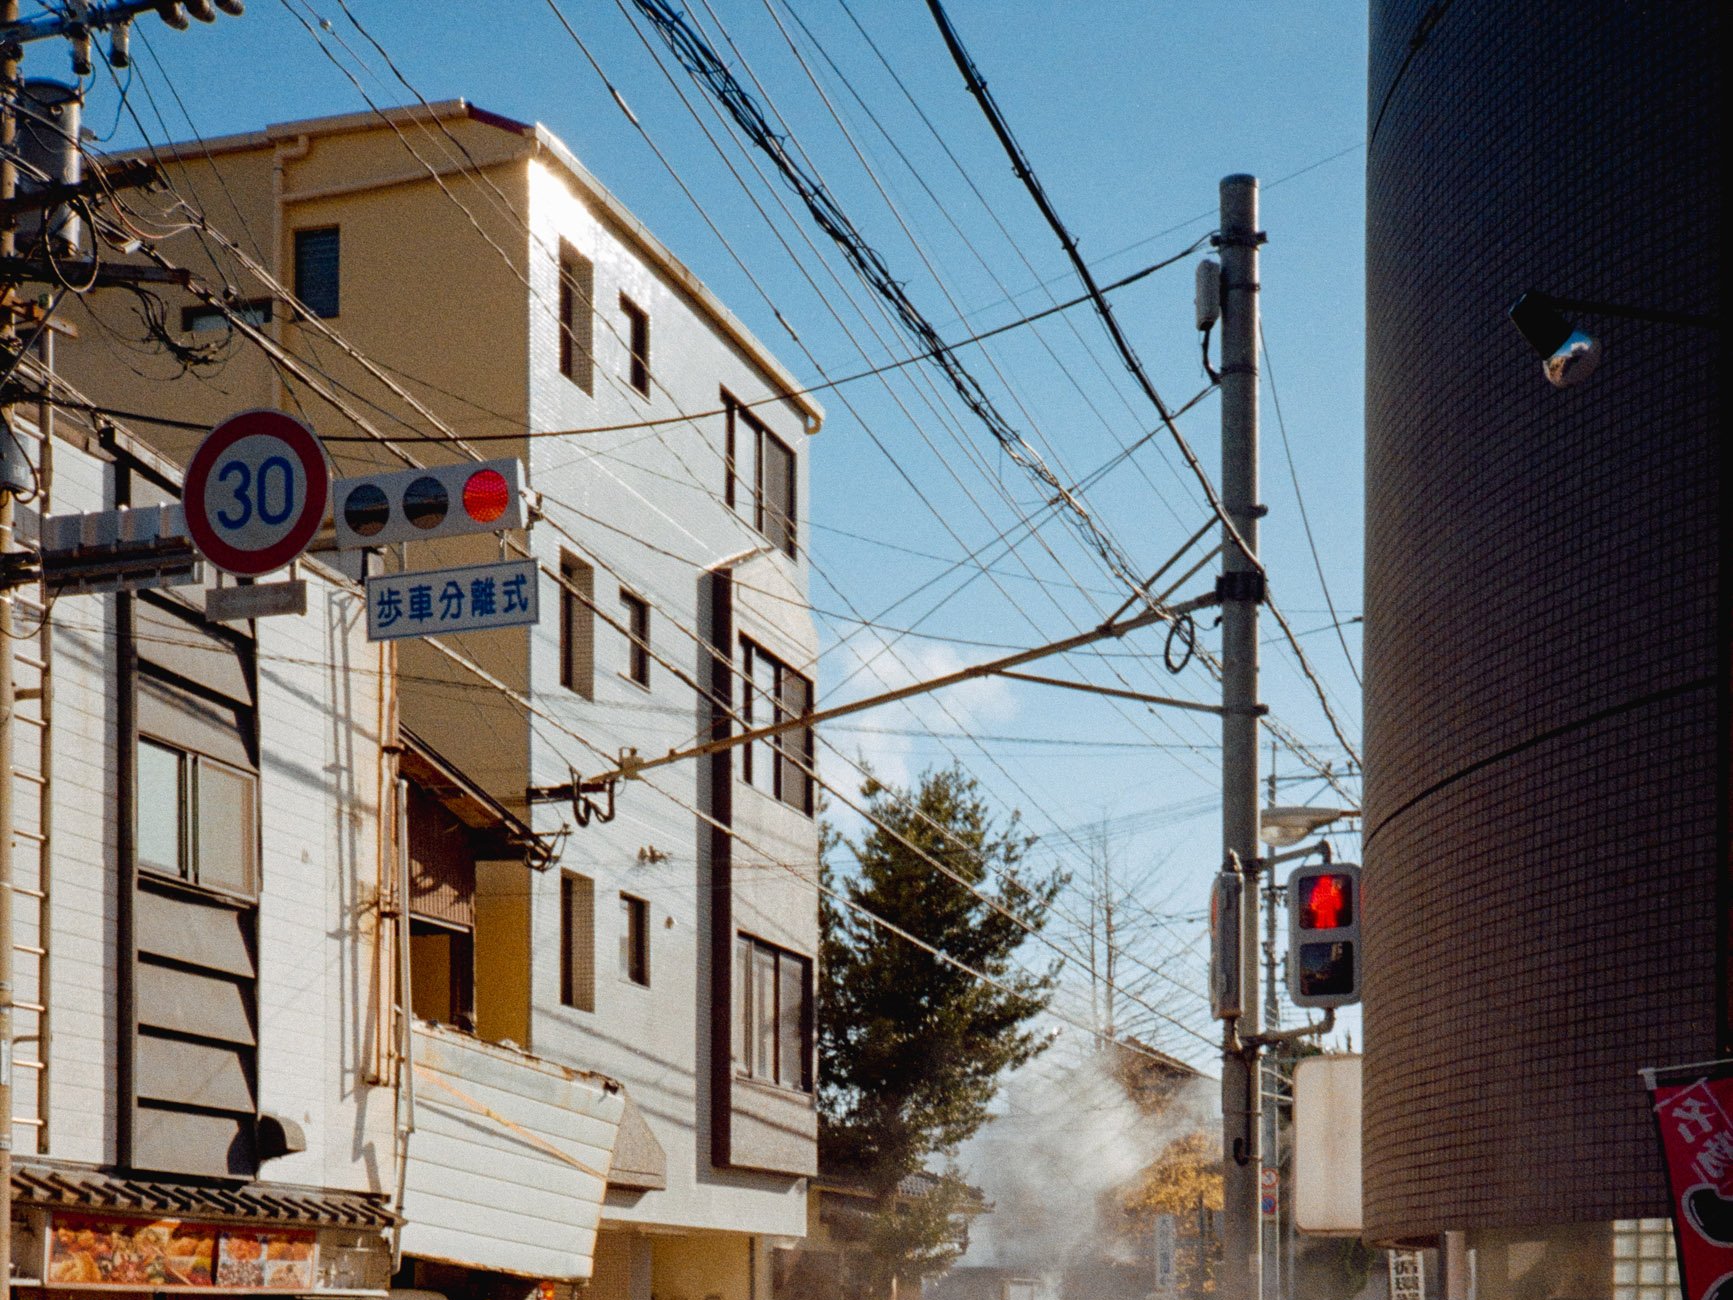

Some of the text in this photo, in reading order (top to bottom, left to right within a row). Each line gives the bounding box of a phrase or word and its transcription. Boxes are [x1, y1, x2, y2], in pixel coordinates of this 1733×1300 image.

[217, 456, 293, 530] 30
[377, 573, 529, 628] 歩車分離式
